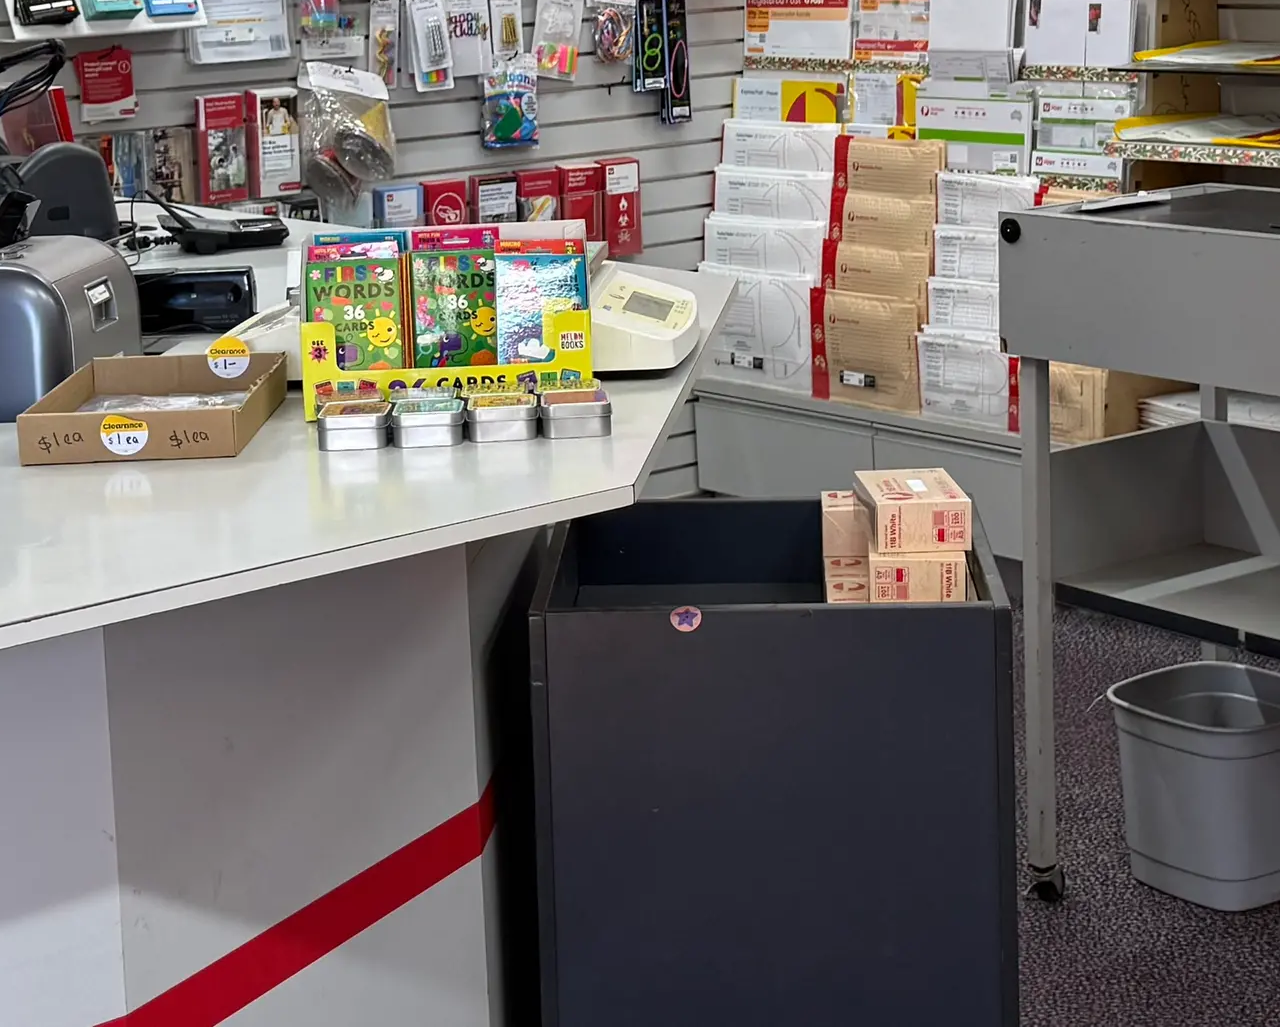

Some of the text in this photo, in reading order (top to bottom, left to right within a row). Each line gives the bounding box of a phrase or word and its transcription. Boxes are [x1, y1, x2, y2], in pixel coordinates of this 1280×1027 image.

[324, 266, 377, 282] FIRST
[313, 282, 394, 302] WORDS
[344, 305, 365, 320] 36
[335, 321, 375, 332] CARDS
[561, 332, 584, 341] MELON
[561, 340, 584, 349] BOOKS
[436, 375, 506, 390] CARDS
